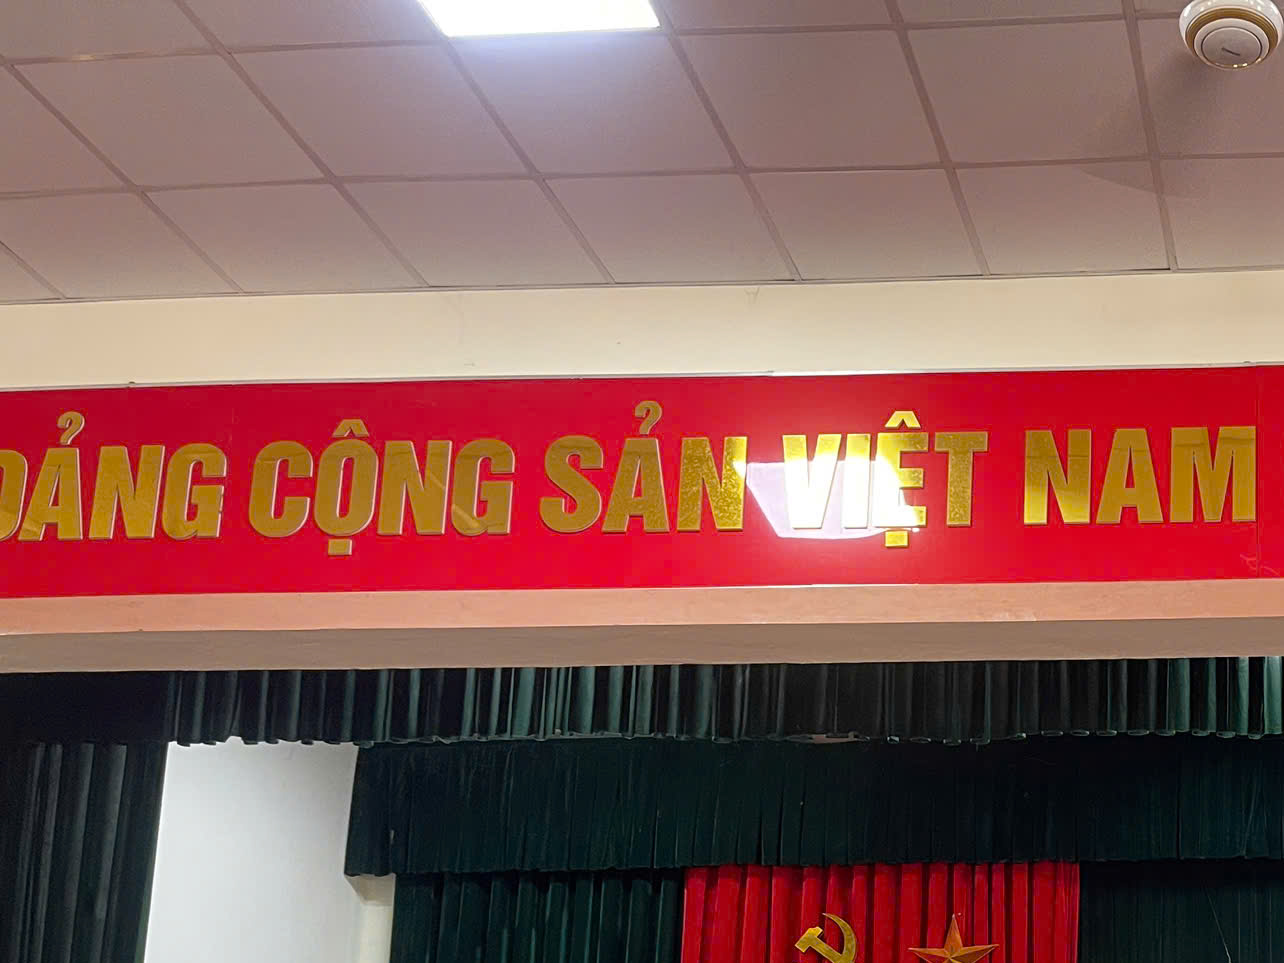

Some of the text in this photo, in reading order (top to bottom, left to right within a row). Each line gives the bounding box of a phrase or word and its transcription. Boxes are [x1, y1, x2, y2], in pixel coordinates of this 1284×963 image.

[249, 419, 515, 556] CỘNG
[540, 401, 747, 534] SẢN
[782, 410, 989, 548] VIỆT
[1023, 425, 1257, 526] NAM
